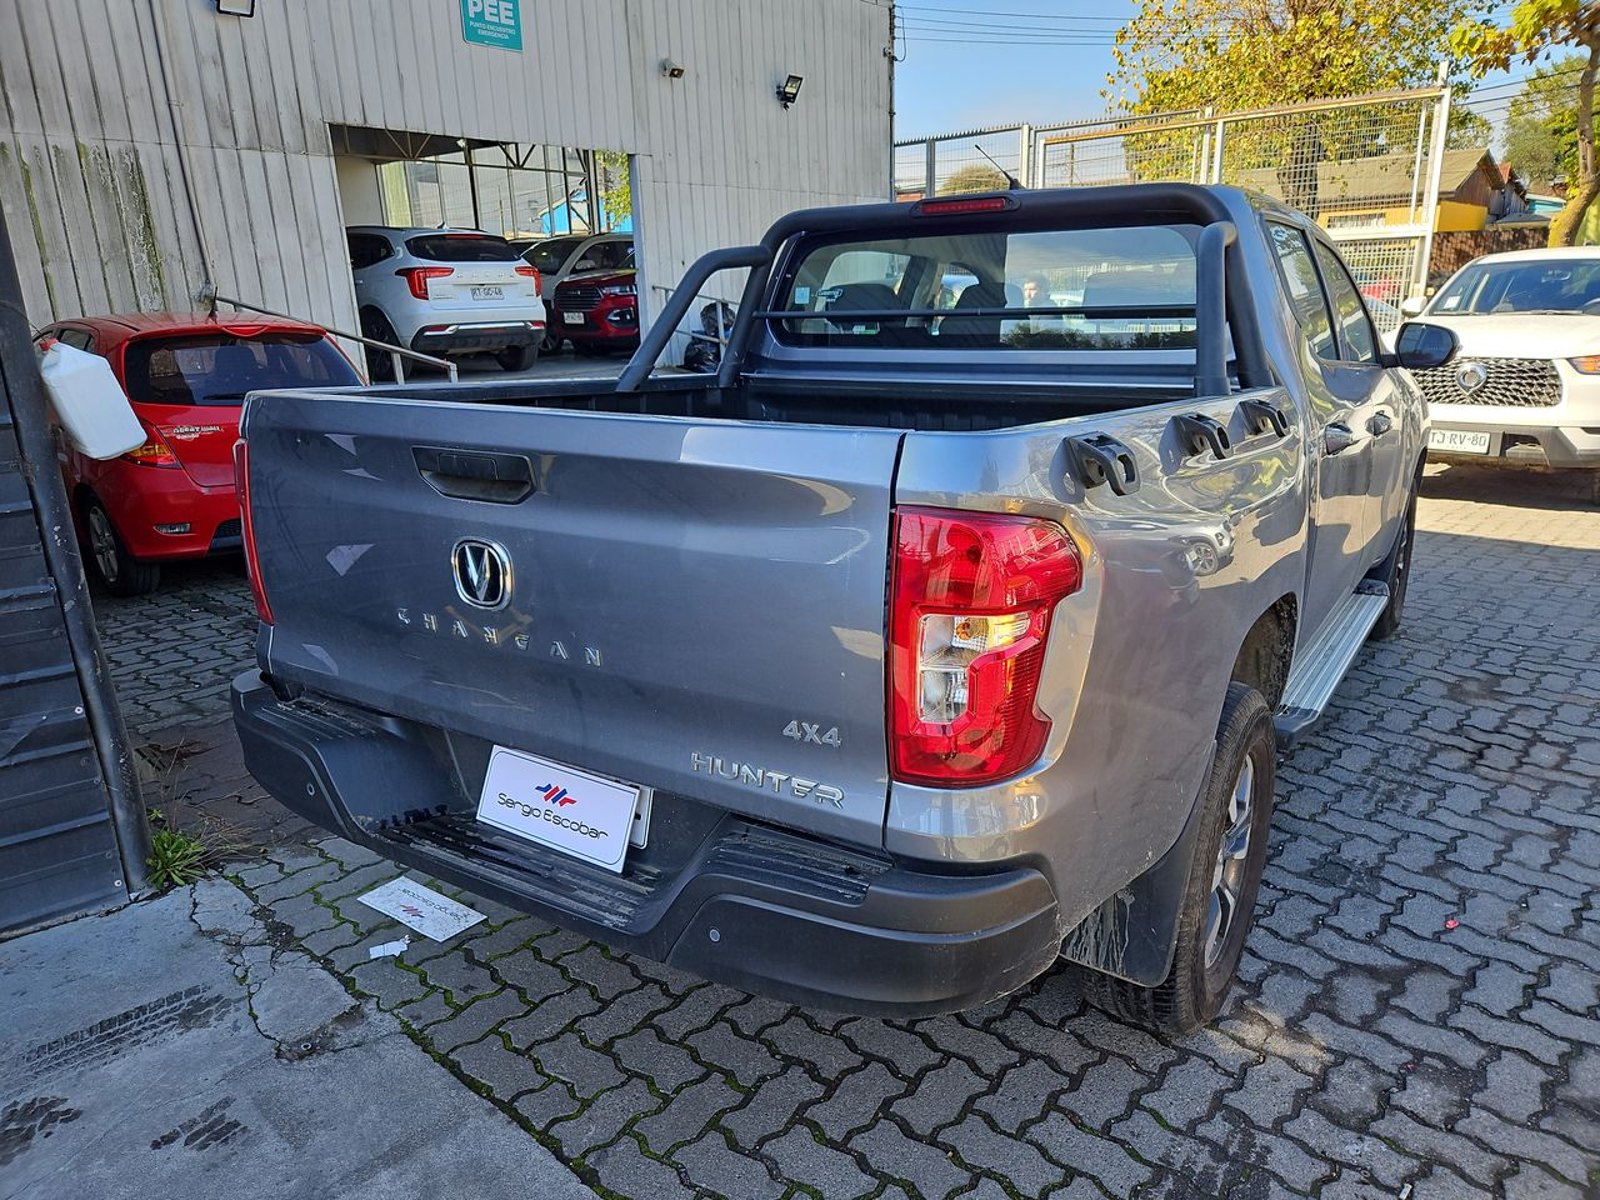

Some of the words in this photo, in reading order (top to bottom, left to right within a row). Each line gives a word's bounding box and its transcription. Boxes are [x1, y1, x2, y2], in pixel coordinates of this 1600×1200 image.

[468, 0, 514, 25] PEE
[398, 608, 602, 667] CHANGAN
[782, 720, 842, 748] 4X4
[691, 752, 845, 809] HUNTER
[497, 792, 542, 818] Sergo
[543, 809, 609, 839] Escobar
